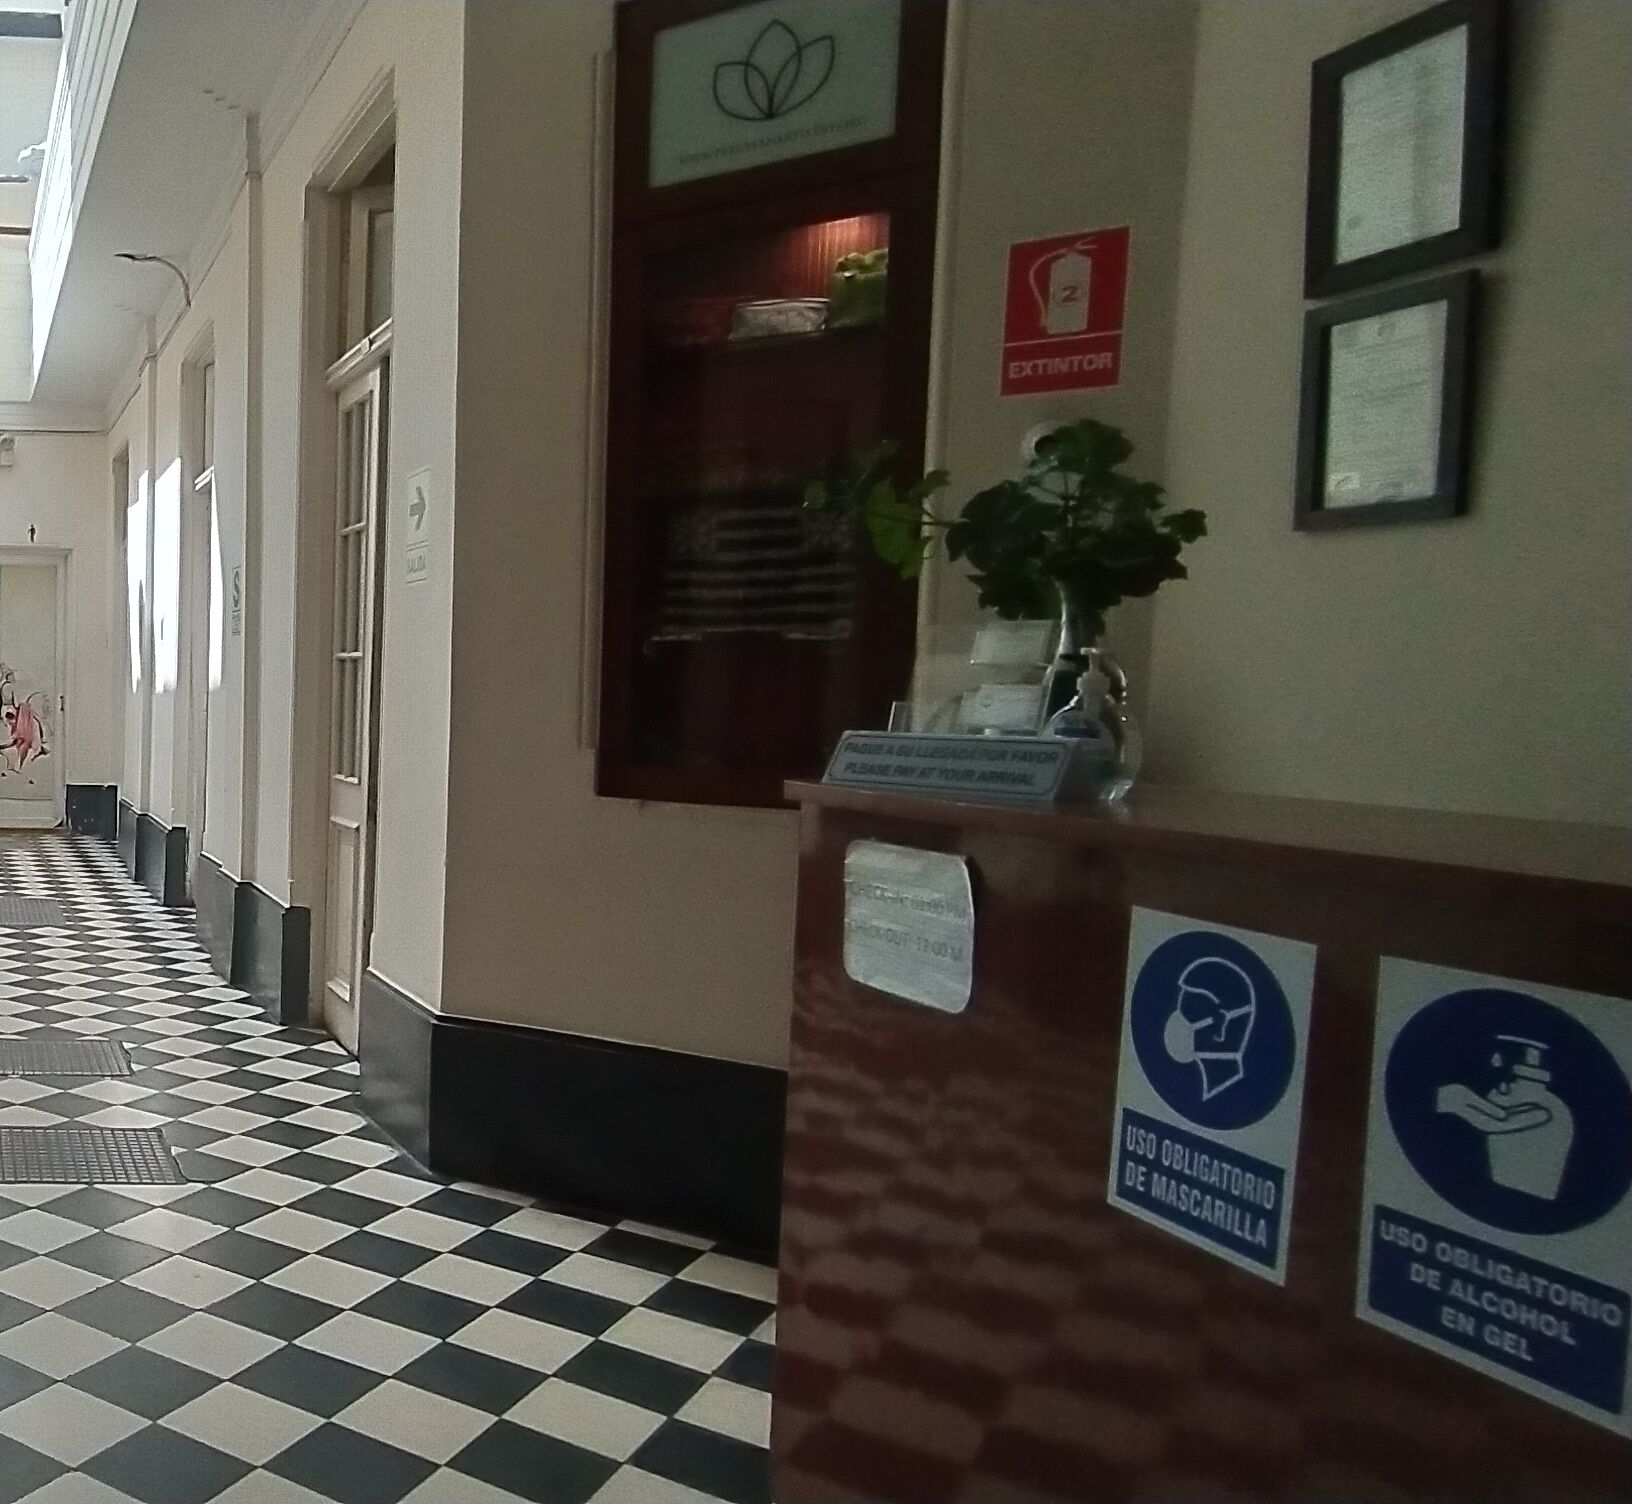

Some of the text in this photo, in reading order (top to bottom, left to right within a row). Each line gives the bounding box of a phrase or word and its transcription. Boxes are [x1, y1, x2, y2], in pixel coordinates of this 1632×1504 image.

[1061, 285, 1078, 303] 2
[1008, 352, 1113, 379] EXTINTOR
[844, 741, 883, 755] PAGUE
[1010, 750, 1059, 764] FAVOR
[844, 762, 892, 776] PLEASE
[919, 766, 937, 779] AT
[939, 767, 979, 782] YOUR
[977, 769, 1036, 786] ARRIVAL
[1126, 1124, 1276, 1210] USO OBLIGATORIO
[1125, 1160, 1267, 1248] DE MASCARILLA
[1380, 1219, 1623, 1327] USO OBLIGATORIO
[1409, 1262, 1577, 1346] DE ALCOHOL
[1441, 1305, 1534, 1362] EN GEL
